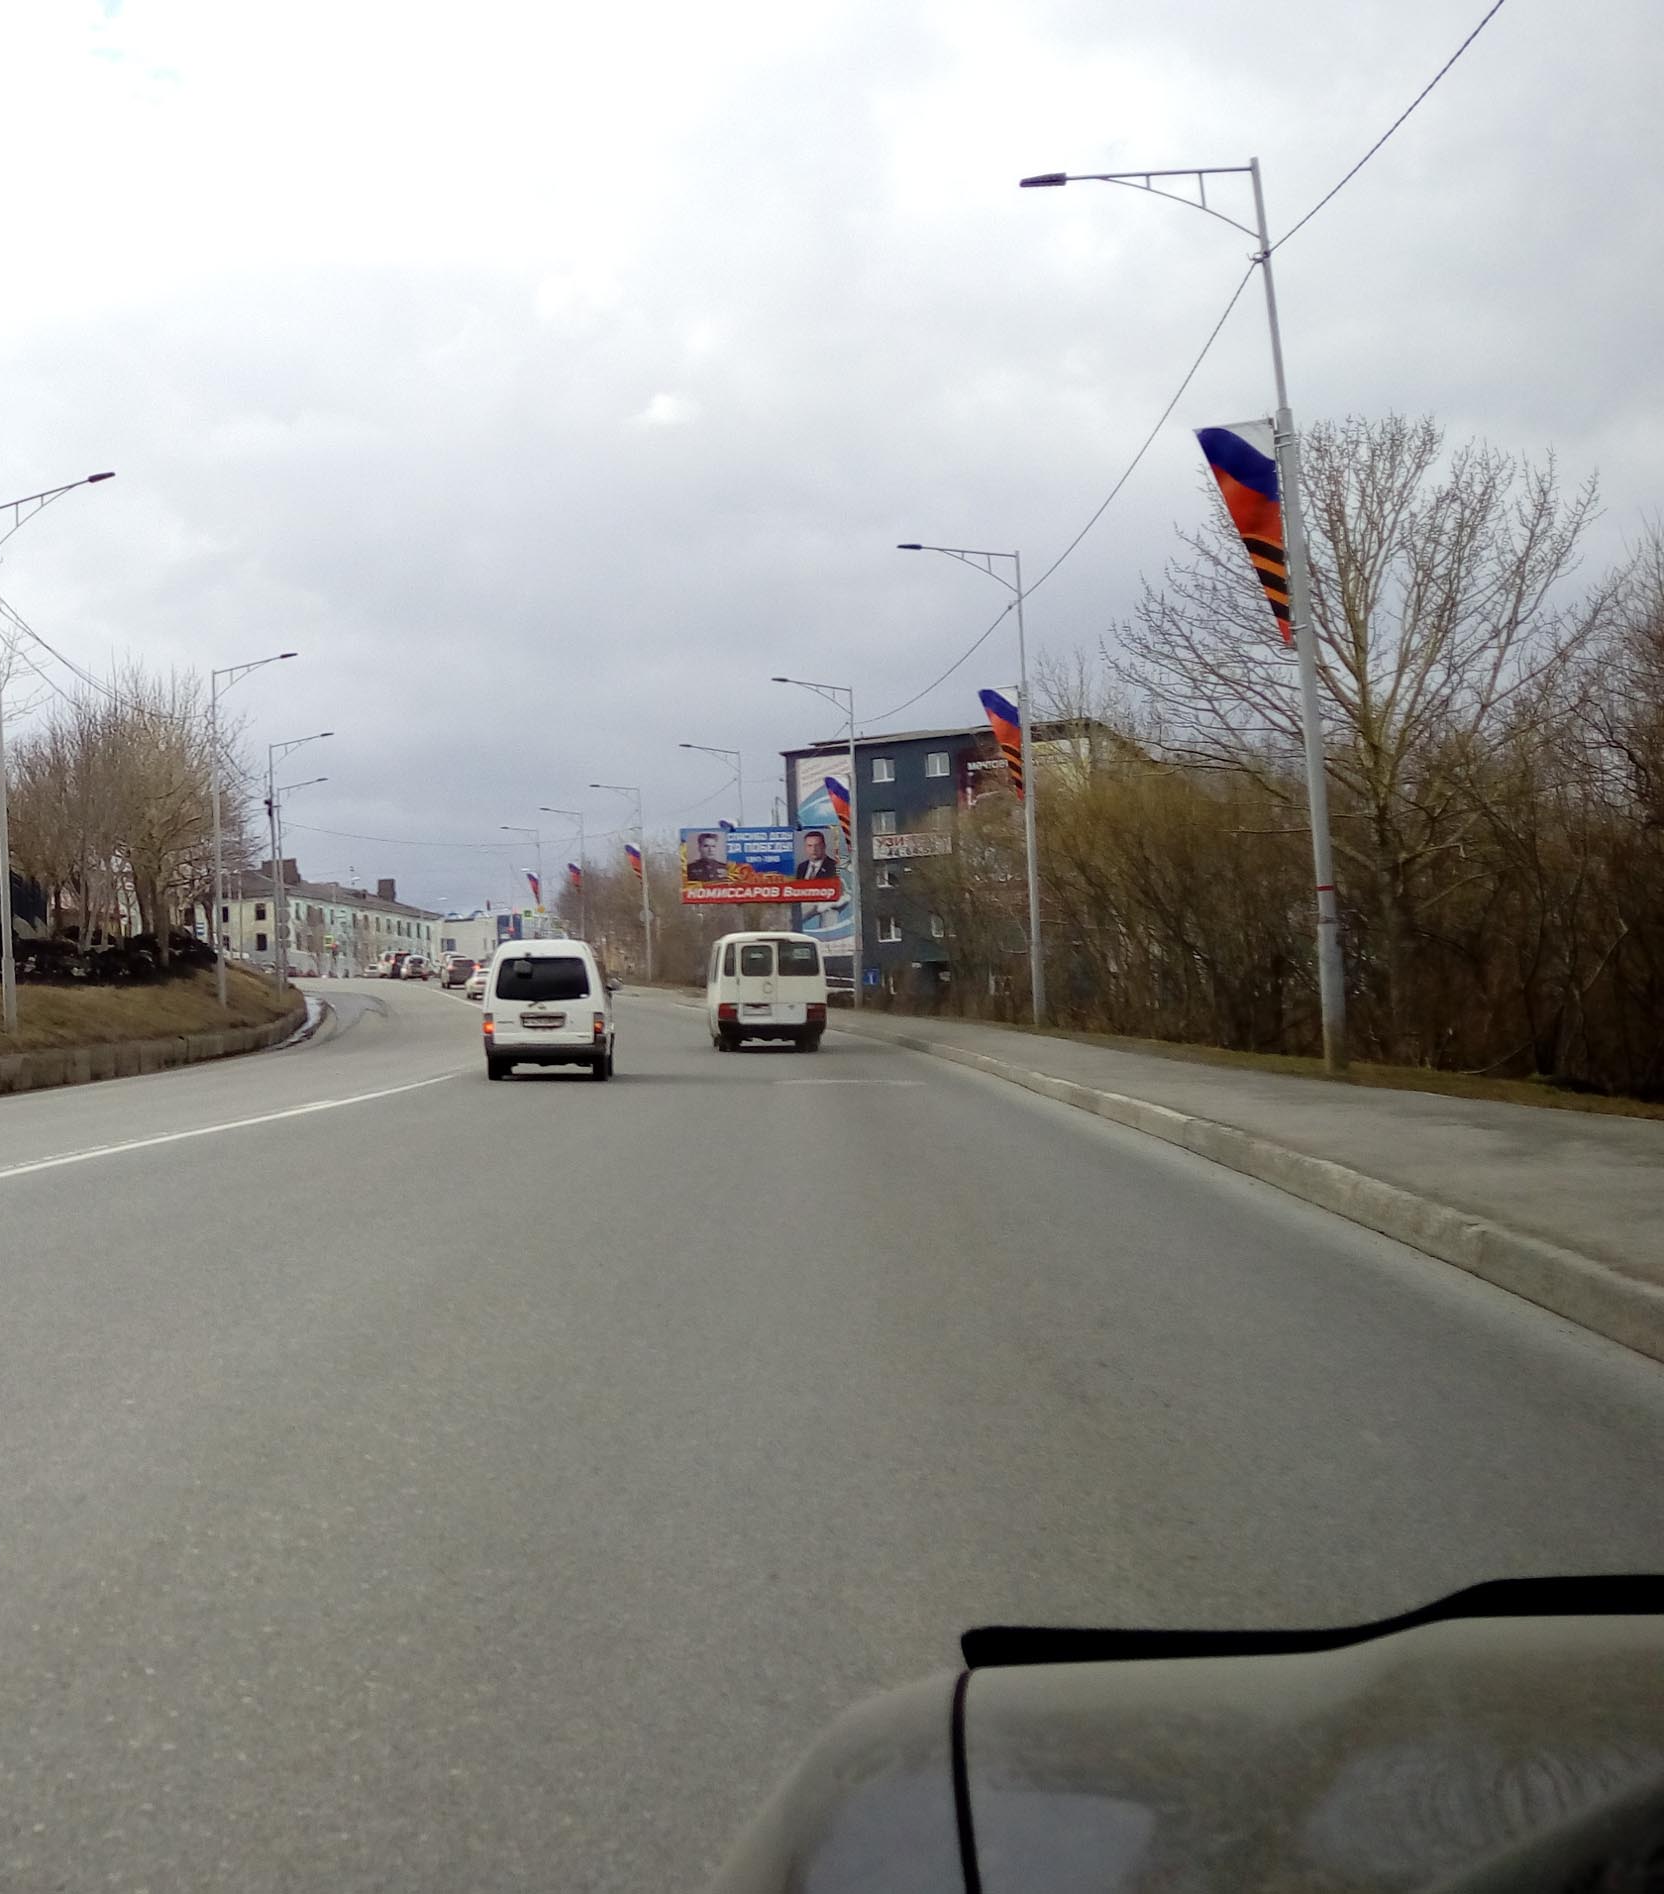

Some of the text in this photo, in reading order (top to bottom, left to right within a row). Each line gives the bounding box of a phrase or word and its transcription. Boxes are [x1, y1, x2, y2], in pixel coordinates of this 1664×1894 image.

[877, 837, 905, 848] УЗИ
[687, 886, 835, 899] КОМИССАРОВ Виктор
